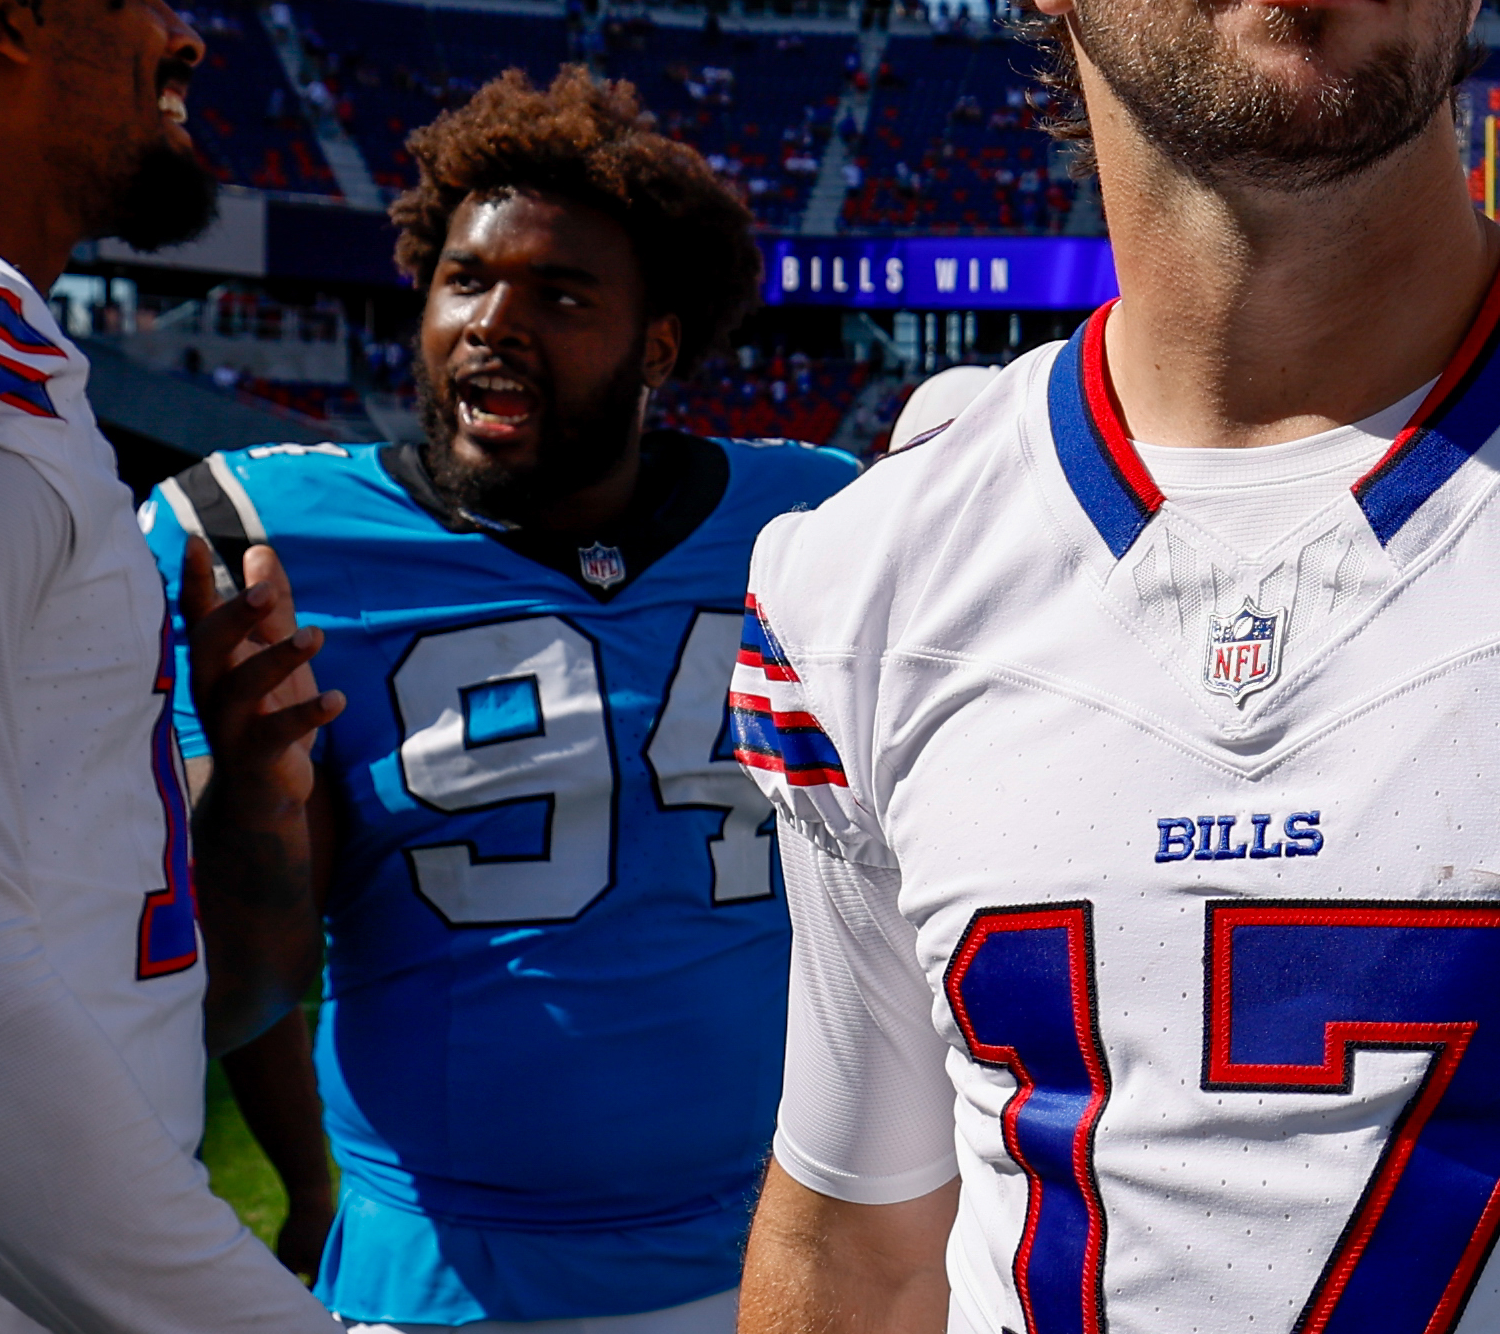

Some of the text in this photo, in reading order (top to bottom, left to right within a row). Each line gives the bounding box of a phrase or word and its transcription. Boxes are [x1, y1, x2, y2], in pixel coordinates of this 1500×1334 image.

[781, 255, 1009, 294] BILLS WIN
[1213, 643, 1267, 683] NFL
[386, 605, 778, 931] 94
[1154, 809, 1325, 863] BILLS
